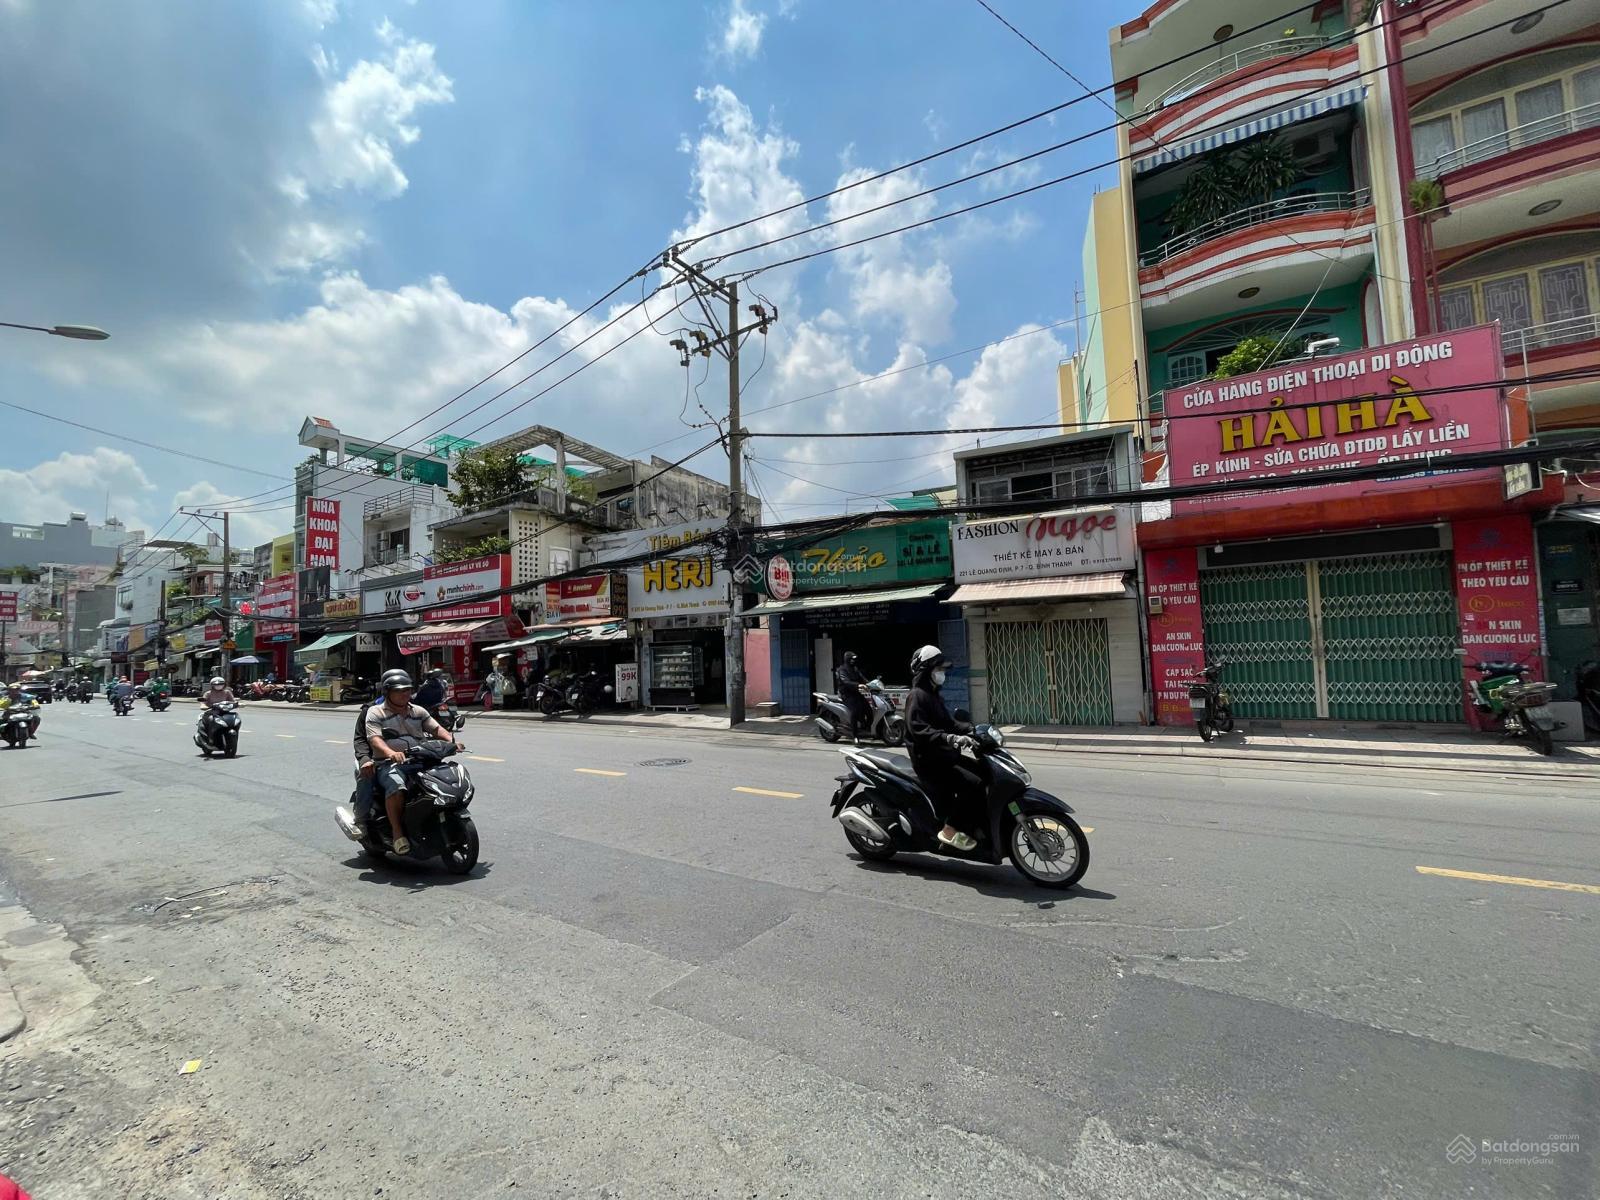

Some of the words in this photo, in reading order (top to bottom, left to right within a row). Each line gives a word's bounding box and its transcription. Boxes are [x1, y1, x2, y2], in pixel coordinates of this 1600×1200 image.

[1183, 387, 1215, 409] CỬA
[1218, 380, 1262, 402] HÀNG
[1267, 370, 1307, 392] ĐIỆN
[1312, 359, 1366, 383] THOẠI
[1371, 353, 1391, 372] DI
[1396, 341, 1453, 367] ĐỘNG
[1219, 397, 1324, 453] HẢI
[1336, 375, 1432, 432] HÀ
[1193, 461, 1210, 477] ÉP
[1215, 456, 1250, 474] KÍNH
[1264, 447, 1295, 467] SỬA
[1298, 441, 1340, 461] CHỮA
[1392, 427, 1423, 449] LẤY
[1429, 420, 1470, 443] LIỀN
[312, 501, 335, 514] NHA
[309, 518, 337, 532] KHOA
[957, 520, 1019, 541] FASHION
[315, 537, 333, 552] ĐẠI
[1034, 549, 1053, 557] MAY
[1065, 546, 1084, 555] BÁN
[310, 555, 336, 567] NAM
[644, 556, 713, 592] HERI
[1499, 620, 1521, 629] SKIN
[621, 672, 636, 680] 99K
